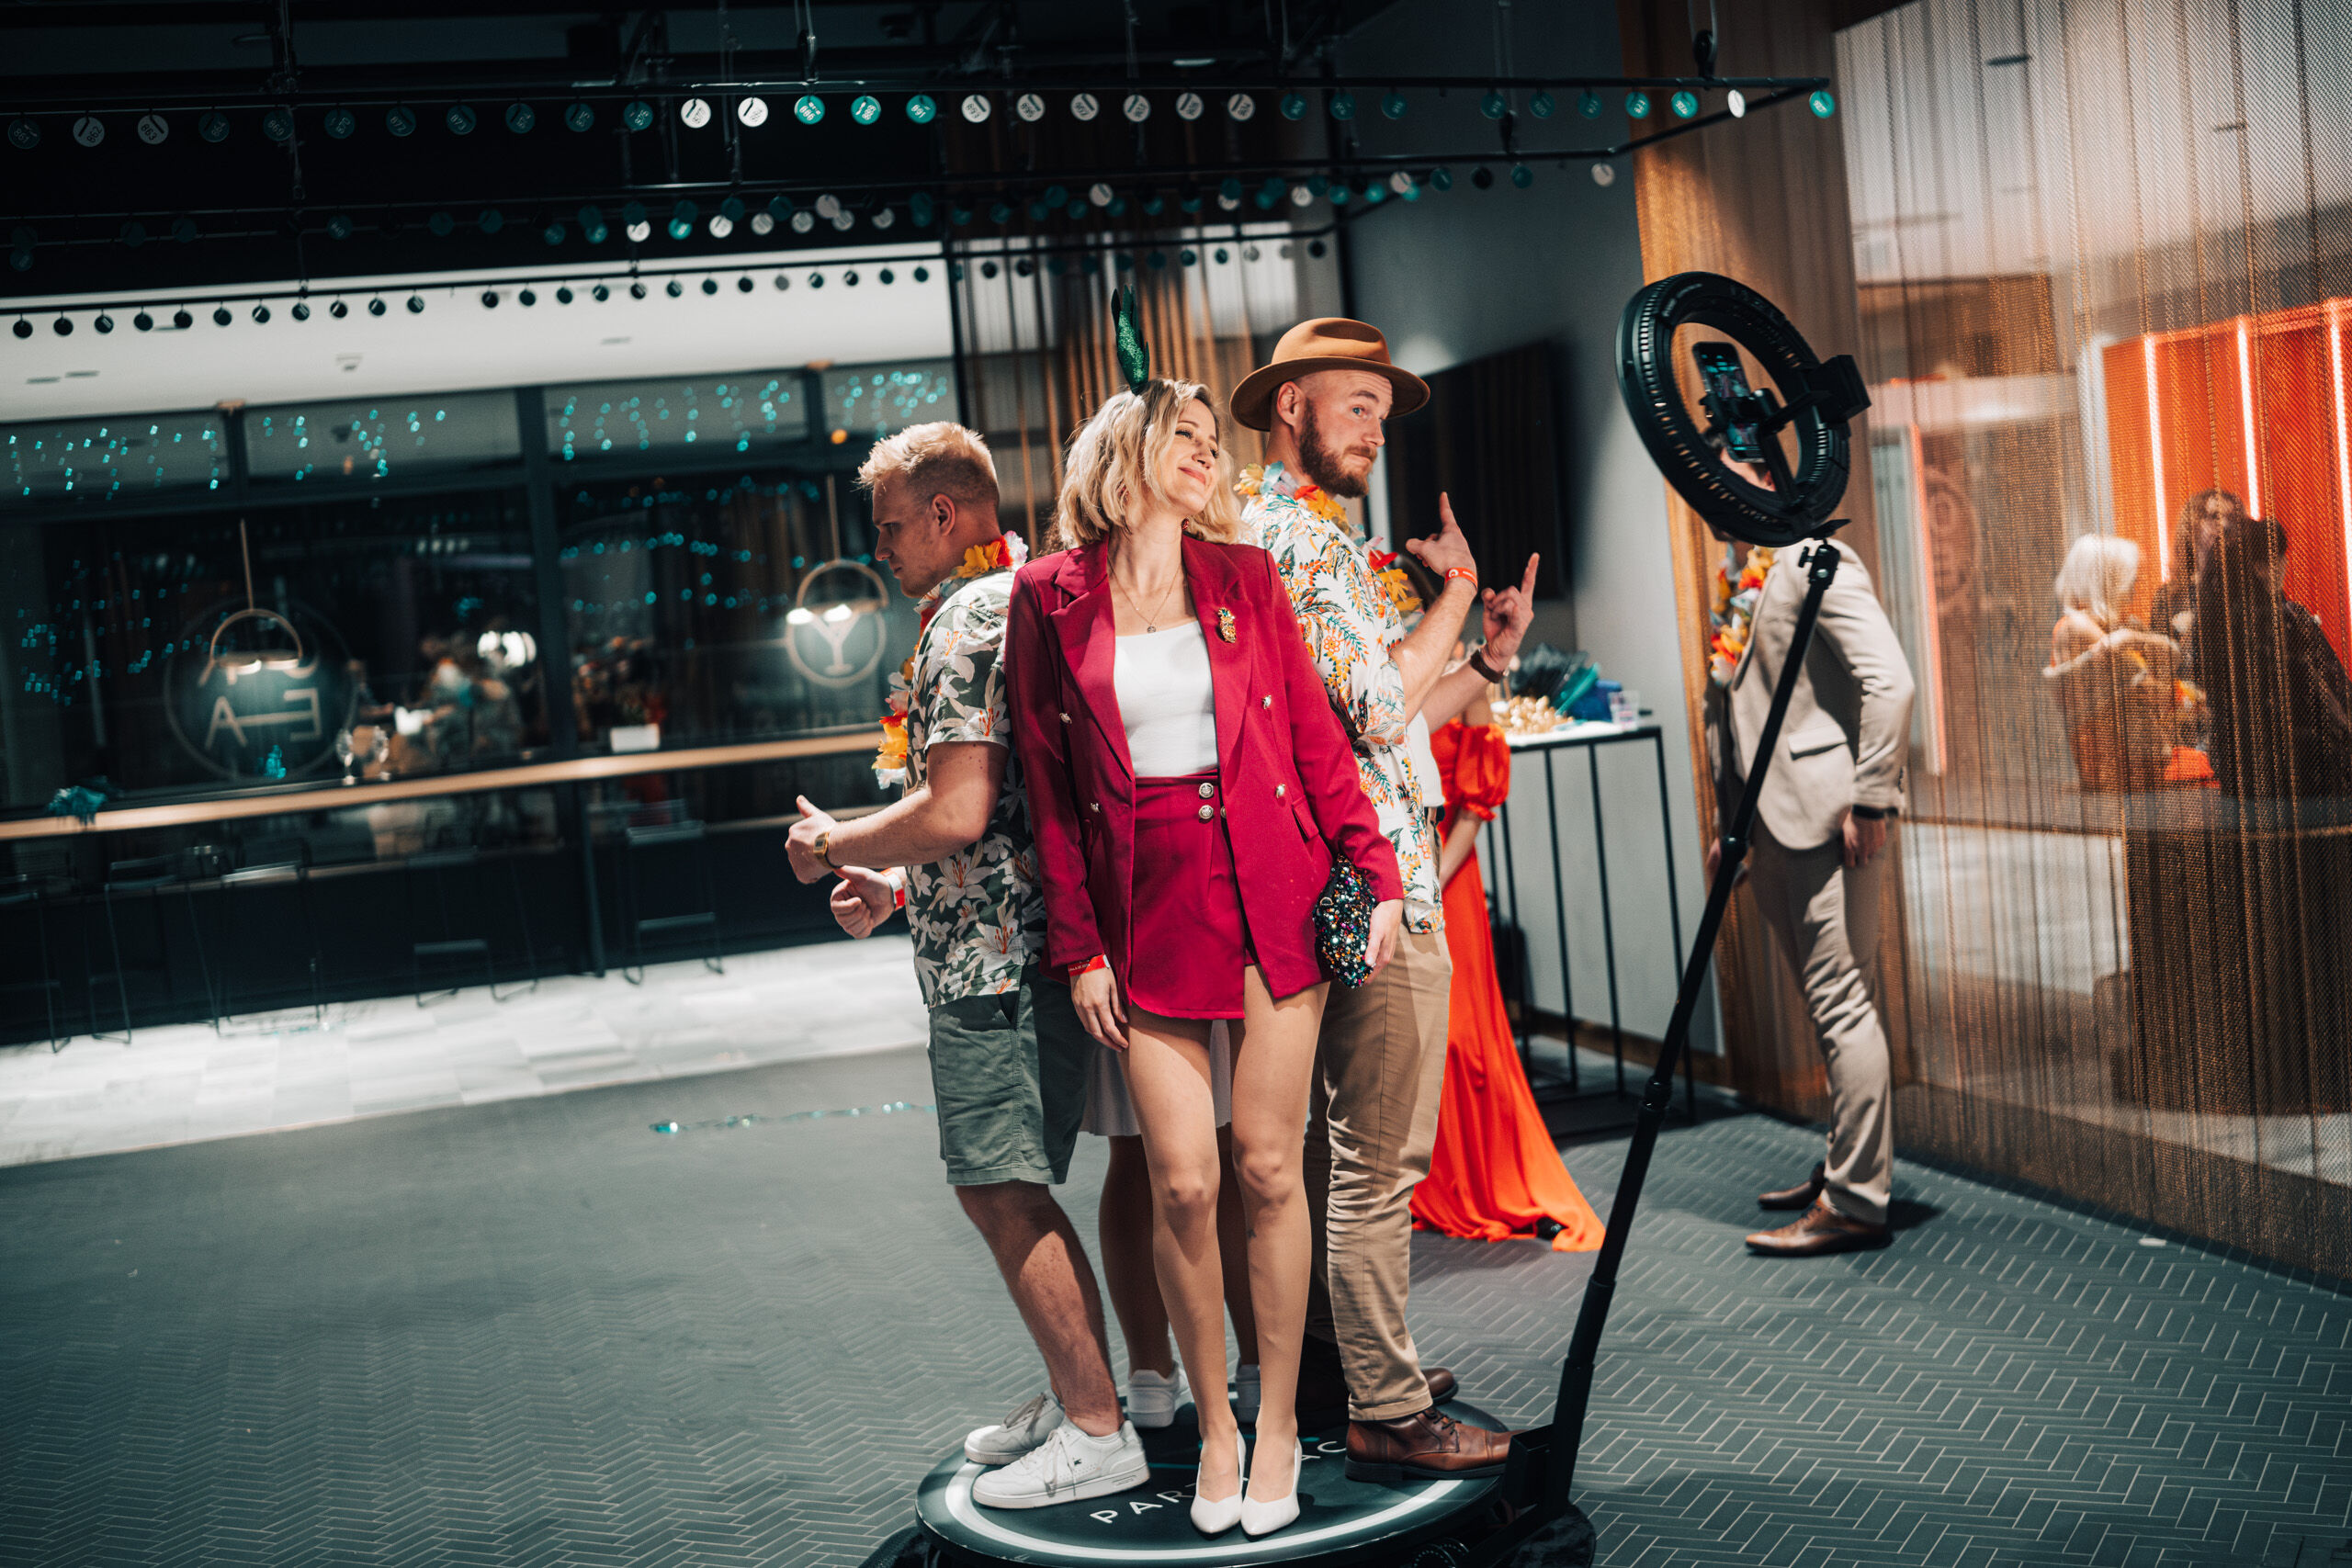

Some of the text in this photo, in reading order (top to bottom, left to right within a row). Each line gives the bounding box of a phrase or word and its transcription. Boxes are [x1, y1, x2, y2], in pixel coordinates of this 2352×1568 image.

[14, 128, 29, 143] 861
[86, 126, 103, 143] 862
[141, 123, 158, 141] 863
[267, 119, 285, 136] 869
